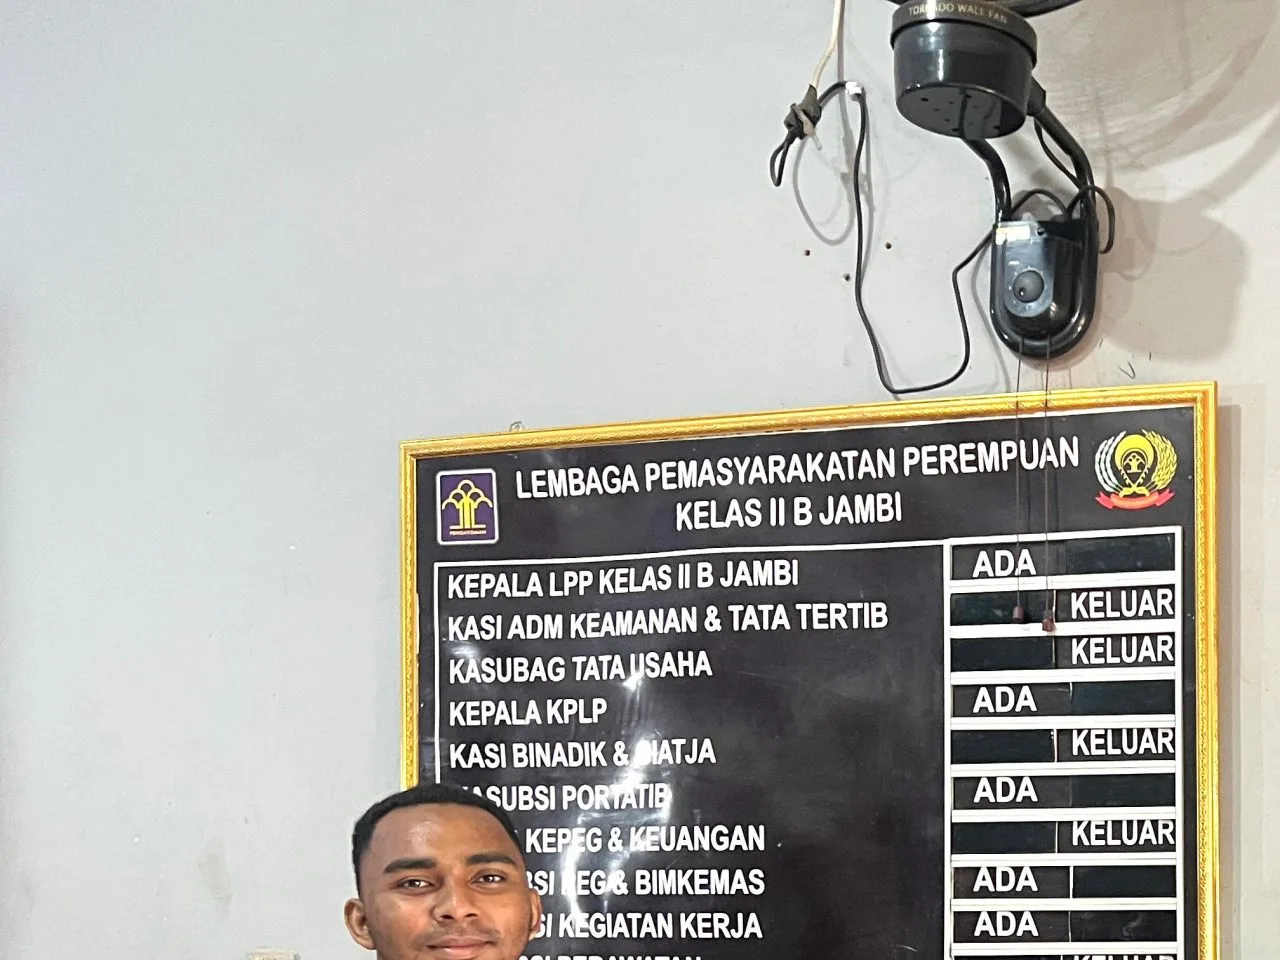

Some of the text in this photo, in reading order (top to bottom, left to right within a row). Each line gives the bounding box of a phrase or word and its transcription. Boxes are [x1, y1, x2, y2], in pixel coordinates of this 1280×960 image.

[516, 436, 1079, 499] LEMBAGA PEMASYARAKATAN PEREMPUAN
[677, 491, 902, 531] KELAS II B JAMBI
[972, 548, 1037, 578] ADA
[448, 559, 799, 599] KEPALA LPP KELAS II B JAMBI
[1070, 588, 1175, 619] KELUAR
[448, 602, 889, 641] KASI ADM KEAMANAN & TATA TERTIB
[1070, 634, 1175, 665] KELUAR
[449, 650, 713, 684] KASUBAG TATA USAHA
[449, 697, 608, 727] KEPALA KPLP
[972, 685, 1037, 713] ADA
[450, 743, 506, 769] KASI
[513, 740, 607, 768] BINADIK
[612, 740, 629, 765] &
[1071, 727, 1175, 756] KELUAR
[973, 776, 1038, 803] ADA
[526, 824, 765, 853] KEPEG & KEUANGAN
[1071, 819, 1175, 846] KELUAR
[610, 869, 628, 895] &
[635, 869, 765, 896] BIMKEMAS
[973, 866, 1038, 892] ADA
[559, 912, 673, 939] KEGIATAN
[680, 912, 763, 939] KERJA
[973, 910, 1039, 937] ADA
